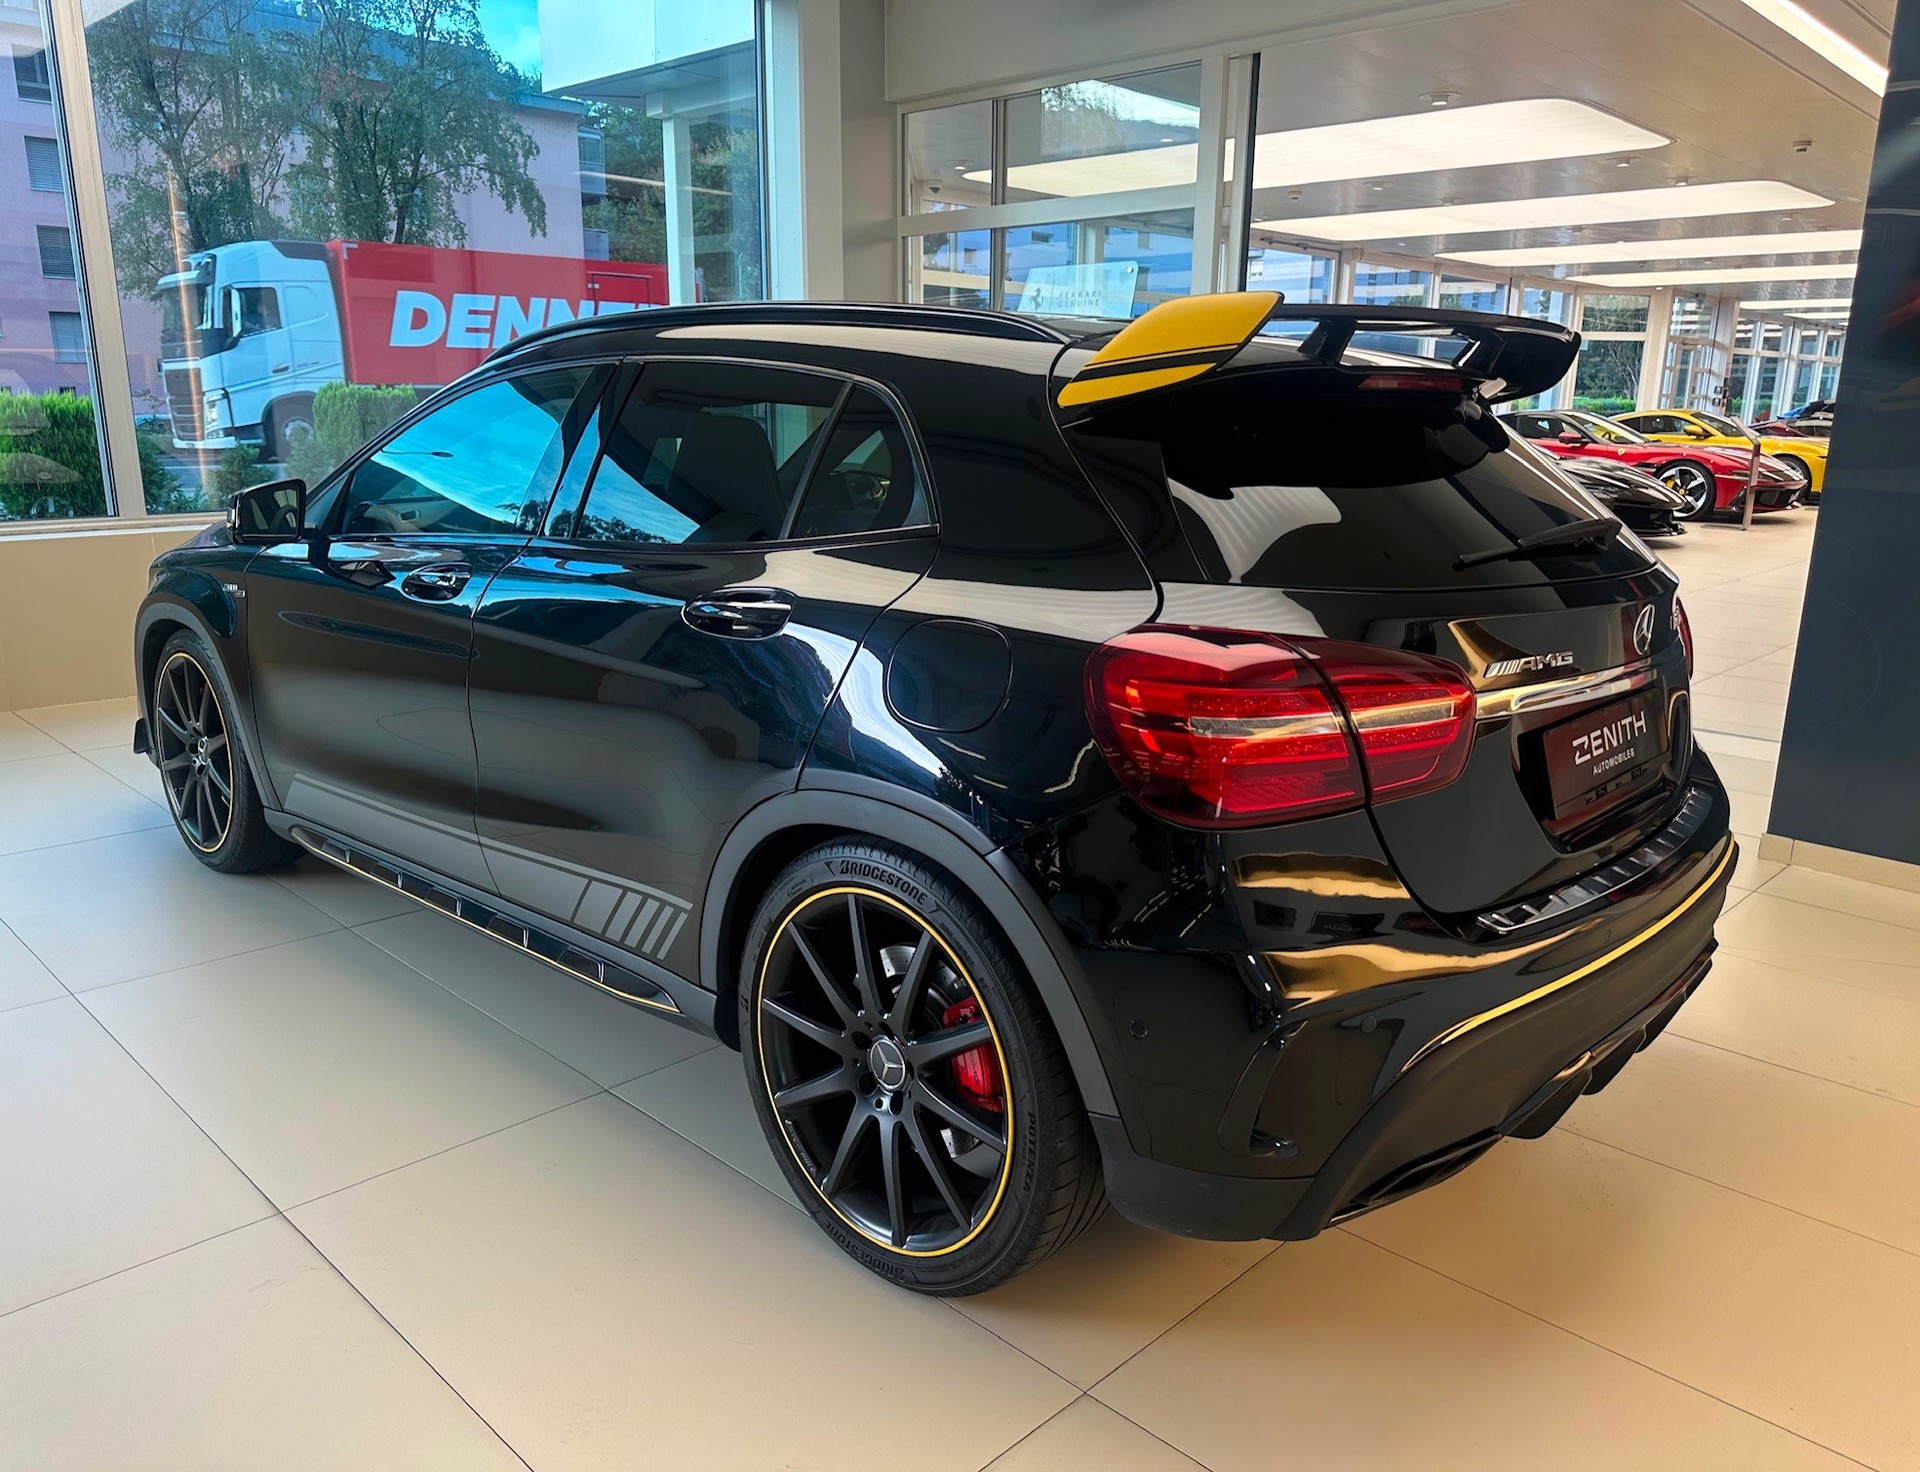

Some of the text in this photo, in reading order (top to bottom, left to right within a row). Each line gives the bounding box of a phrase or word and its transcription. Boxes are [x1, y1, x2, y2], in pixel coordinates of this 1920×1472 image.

[1057, 299, 1100, 308] GENUINE
[1059, 290, 1102, 299] FERRARI
[390, 290, 669, 349] DEN
[1518, 651, 1574, 672] AMG
[1572, 711, 1647, 765] ZENITH
[1593, 748, 1635, 776] AUTOMOBILES
[840, 860, 928, 906] BRIDGESTONE
[1022, 1111, 1037, 1193] POTENZA
[824, 1219, 905, 1280] BRIDGESTONE
